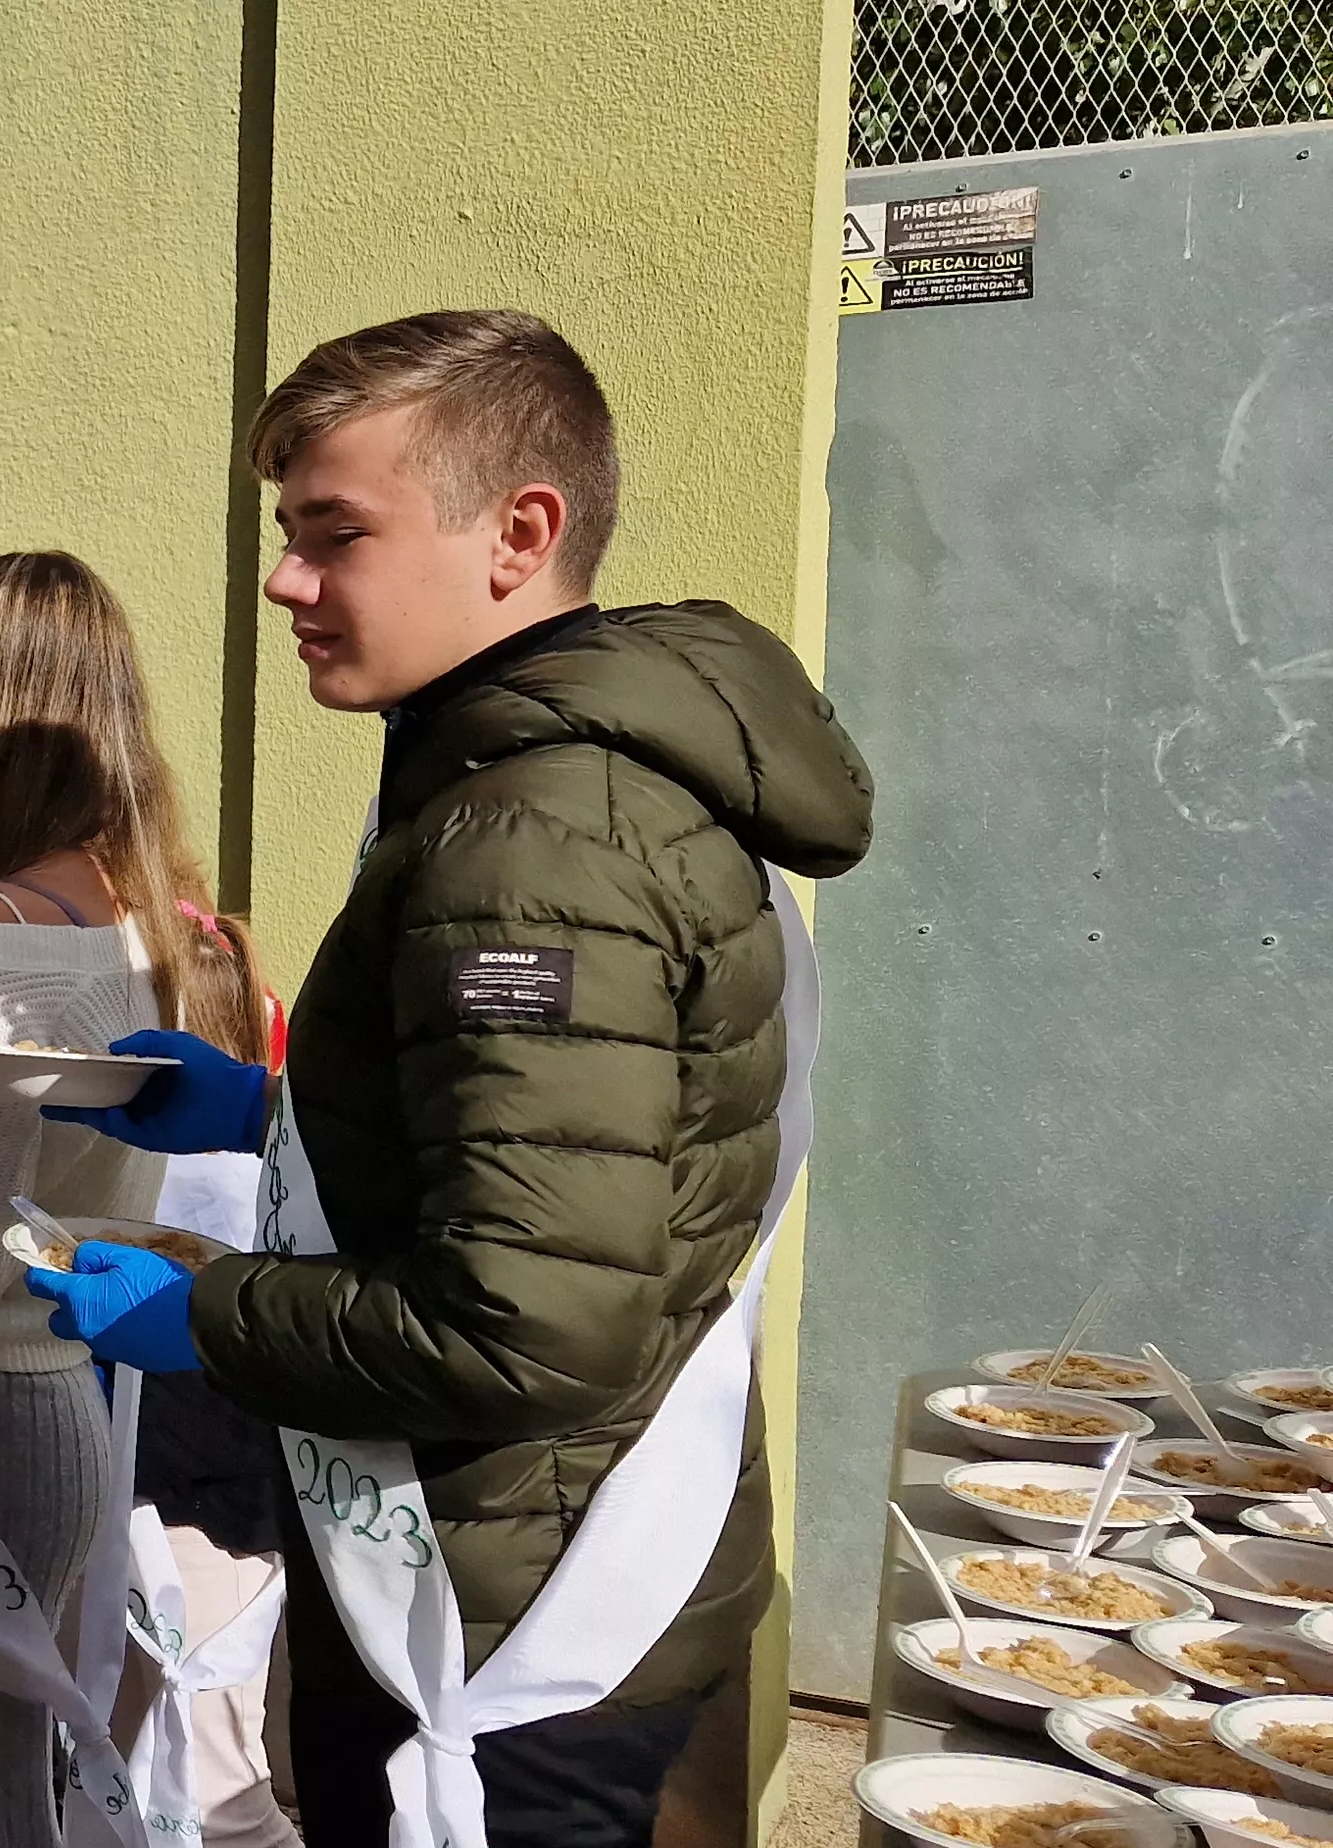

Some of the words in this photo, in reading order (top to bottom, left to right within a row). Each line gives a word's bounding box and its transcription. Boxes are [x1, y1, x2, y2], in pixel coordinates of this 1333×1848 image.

[909, 232, 922, 240] NO
[902, 250, 1024, 274] ¡PRECAUCIÓN!
[893, 288, 910, 298] NO
[913, 286, 928, 296] ES
[478, 951, 539, 965] ECOALF
[296, 1438, 433, 1569] 2023
